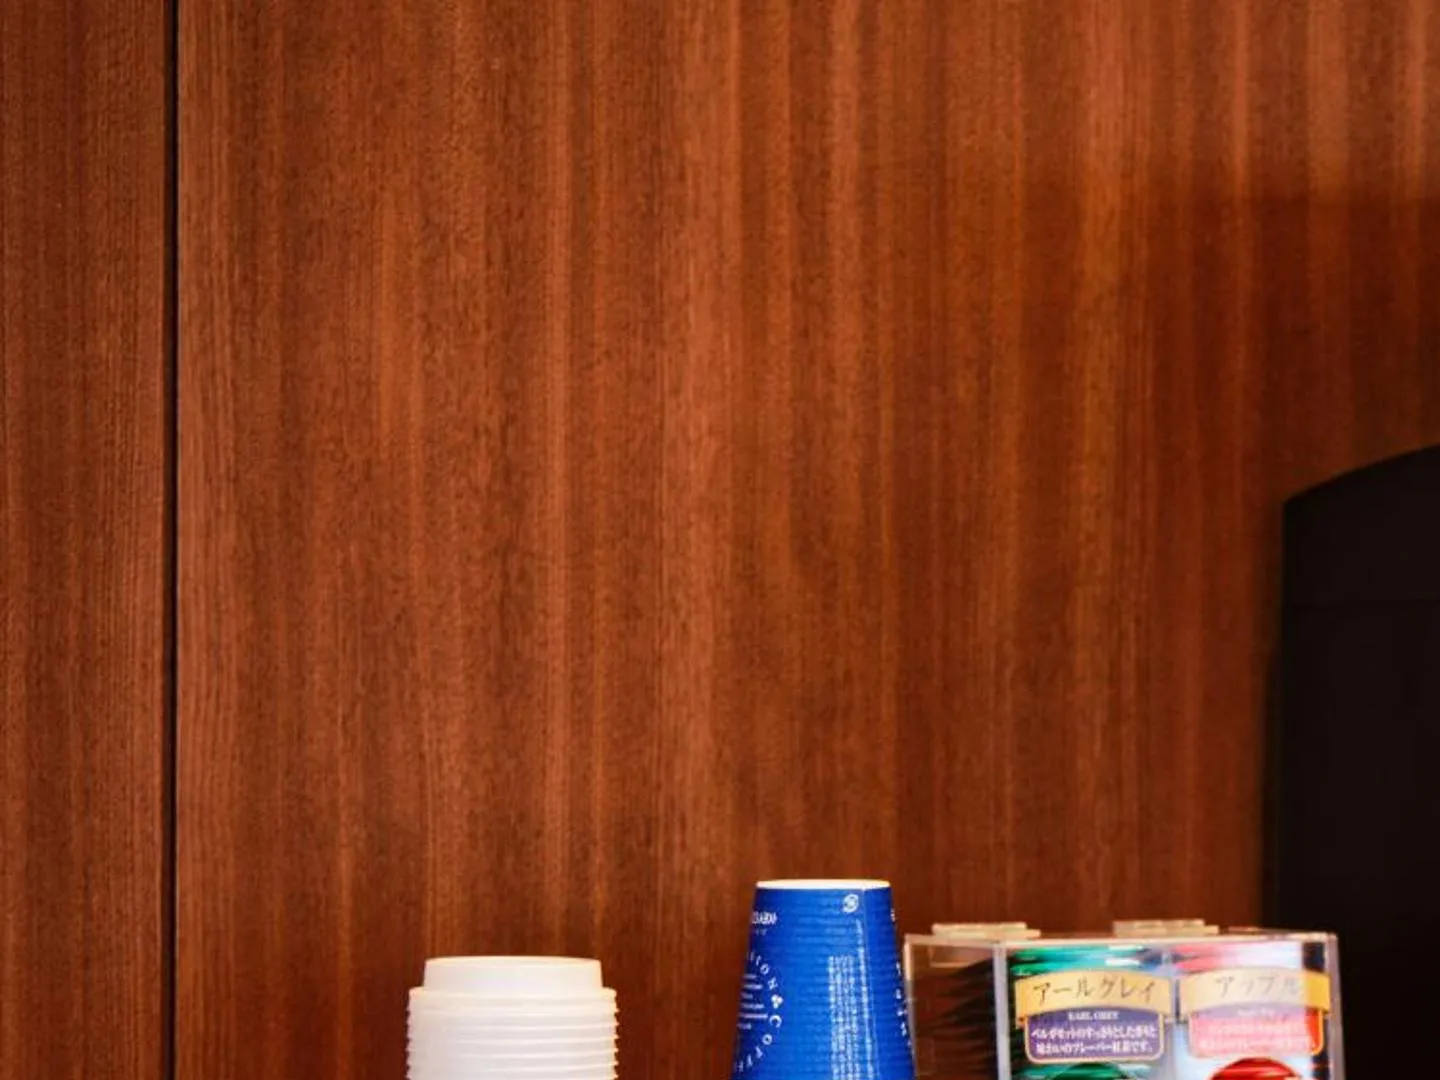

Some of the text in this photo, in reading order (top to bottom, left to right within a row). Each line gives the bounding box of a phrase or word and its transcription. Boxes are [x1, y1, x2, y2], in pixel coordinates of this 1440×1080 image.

[1033, 977, 1156, 1005] アールグレイ
